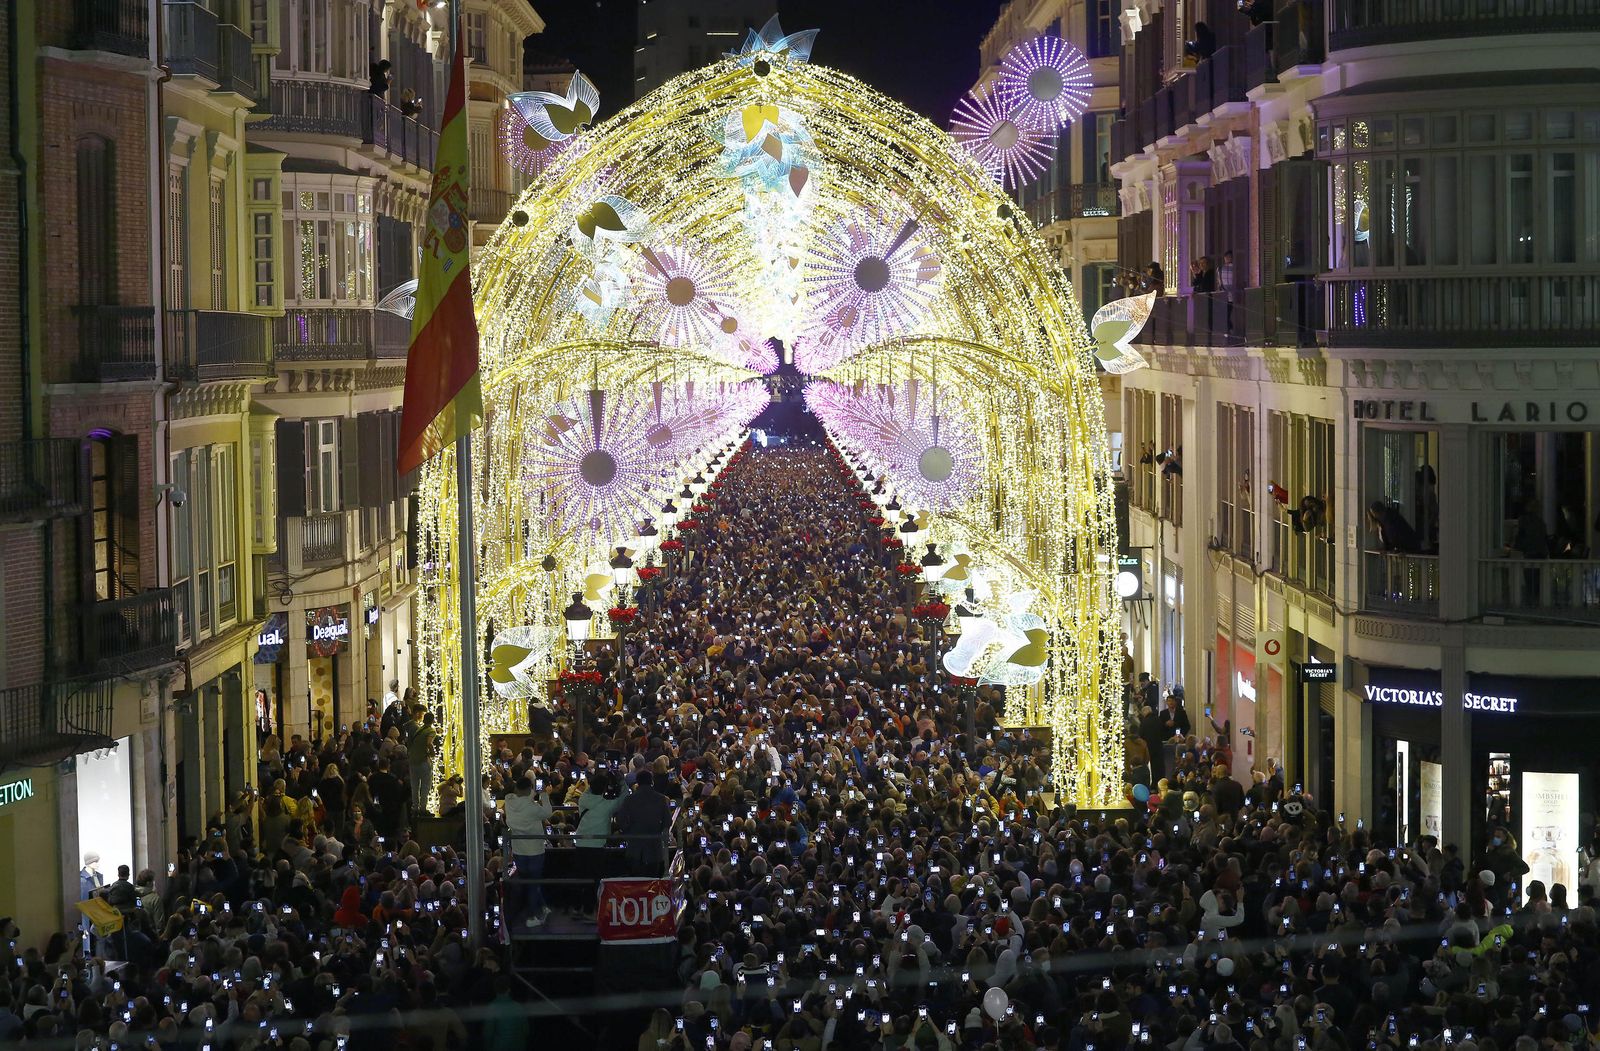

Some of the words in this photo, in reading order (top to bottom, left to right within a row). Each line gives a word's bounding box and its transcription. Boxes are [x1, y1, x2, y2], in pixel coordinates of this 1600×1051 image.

[1353, 399, 1436, 422] HOTEL
[1470, 401, 1588, 423] LARIO
[1364, 684, 1443, 707] VICTORIA'S
[1464, 692, 1518, 713] SECRET
[608, 896, 652, 927] 101
[655, 900, 669, 911] tv
